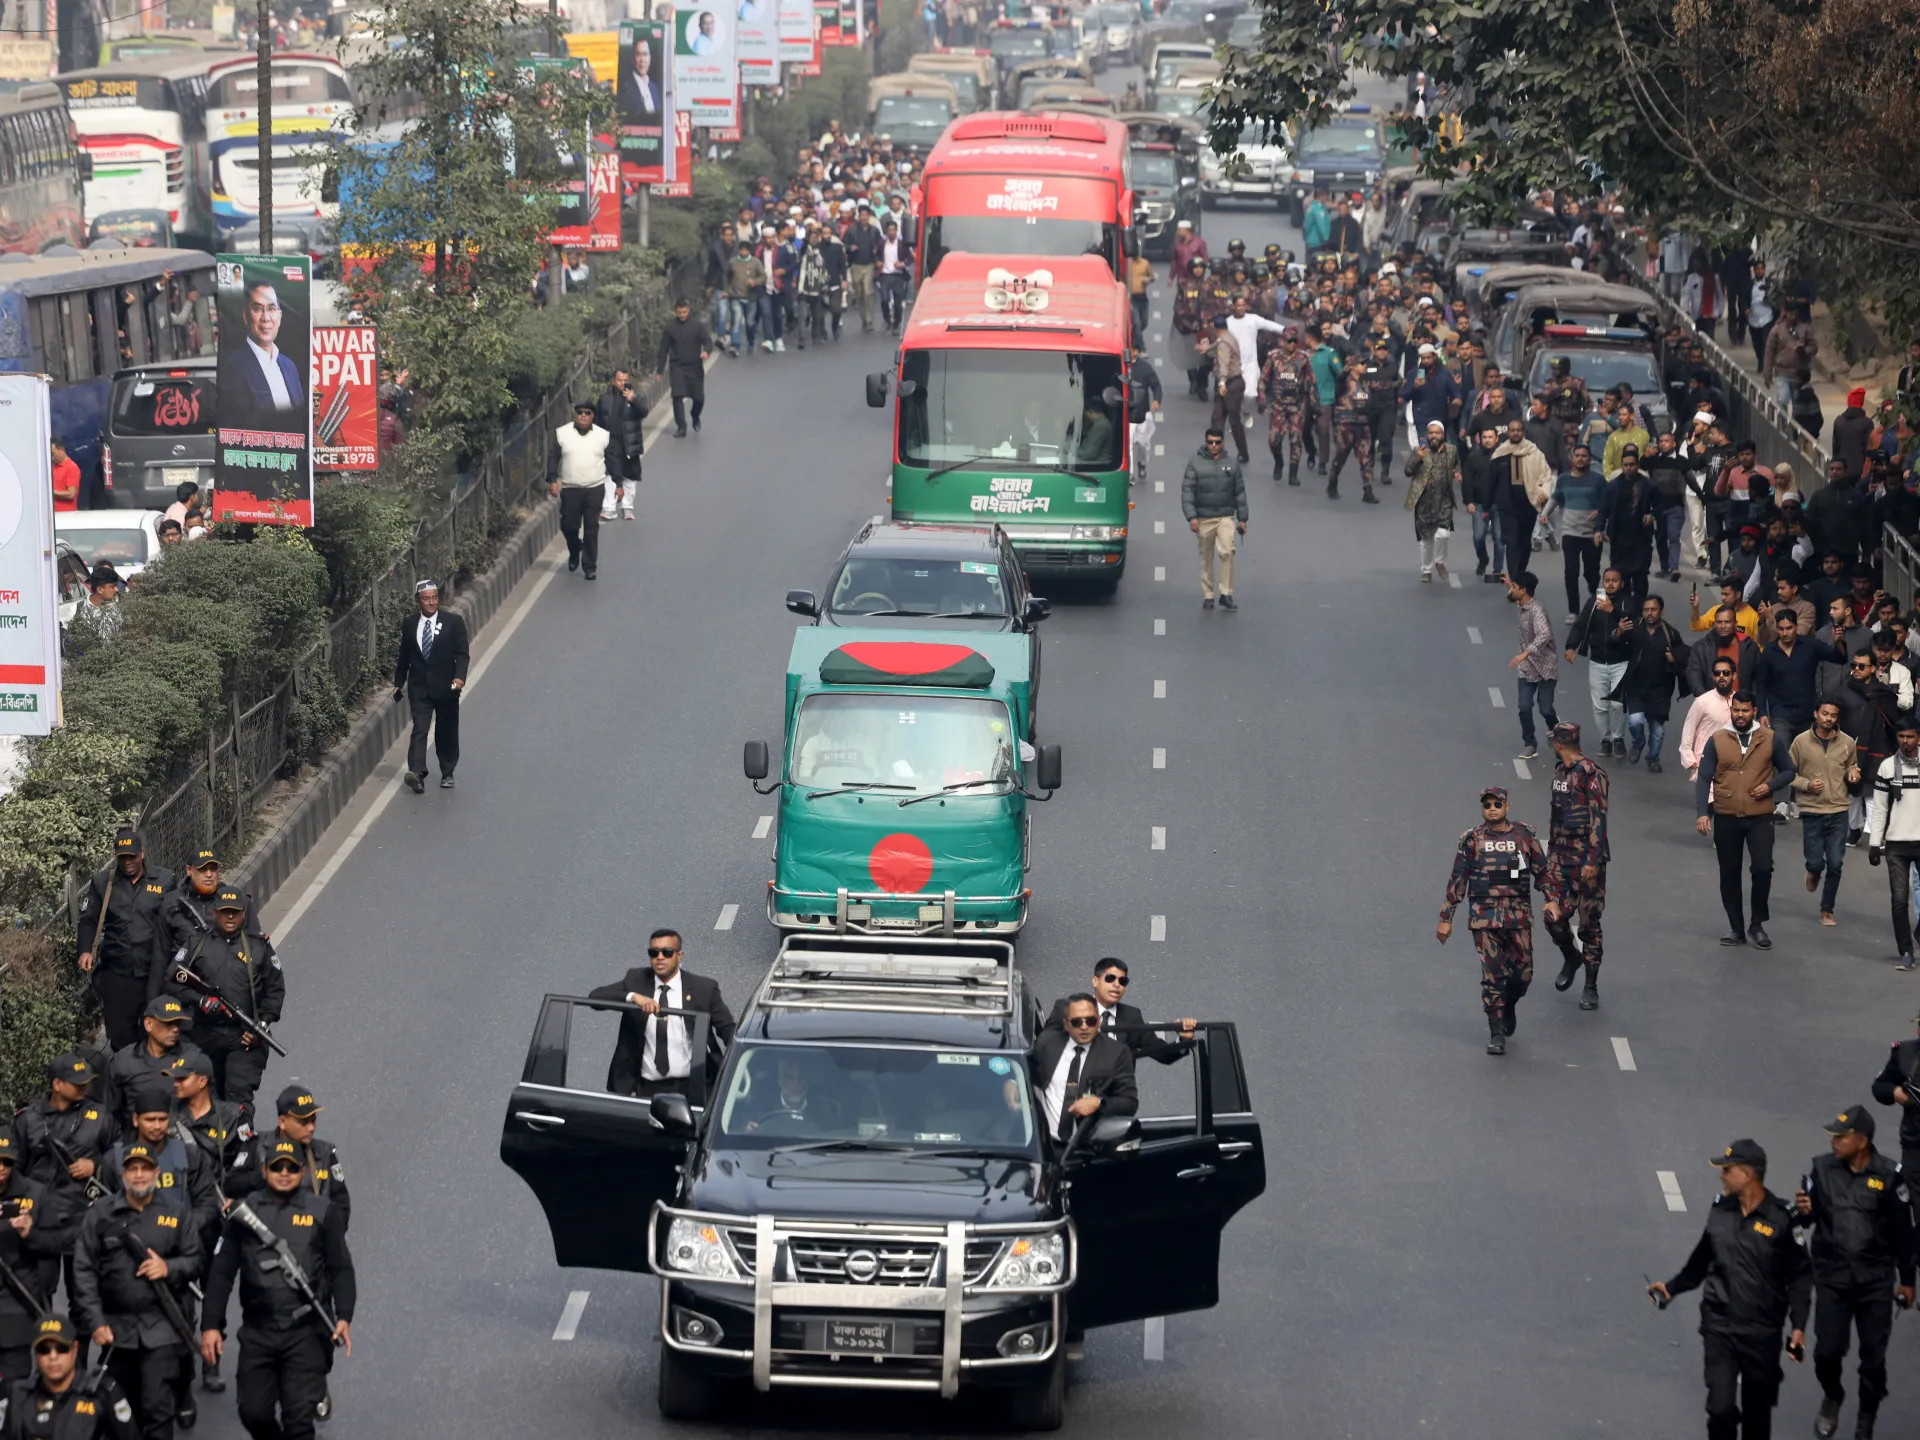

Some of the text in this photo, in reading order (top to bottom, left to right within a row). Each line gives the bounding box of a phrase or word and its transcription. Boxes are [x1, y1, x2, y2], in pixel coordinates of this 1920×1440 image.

[101, 80, 137, 97] বাংলা
[986, 194, 1059, 213] বাংলাদেশ
[313, 329, 376, 354] NWAR
[313, 353, 376, 387] SPAT
[313, 453, 375, 465] NCE 1978
[989, 477, 1033, 498] সবার
[997, 491, 1022, 501] আগে
[970, 495, 1051, 514] বাংলাদেশ
[1552, 779, 1568, 792] BGB
[118, 838, 132, 846] RAB
[1484, 841, 1516, 852] BGB
[146, 884, 162, 894] RAB
[949, 1055, 972, 1064] SSF
[85, 1110, 98, 1120] AB
[276, 1142, 294, 1153] RAB
[315, 1169, 329, 1180] AB
[157, 1215, 178, 1229] RAB
[292, 1214, 314, 1227] RAB
[833, 1325, 886, 1339] ঢাকা মেট্রো
